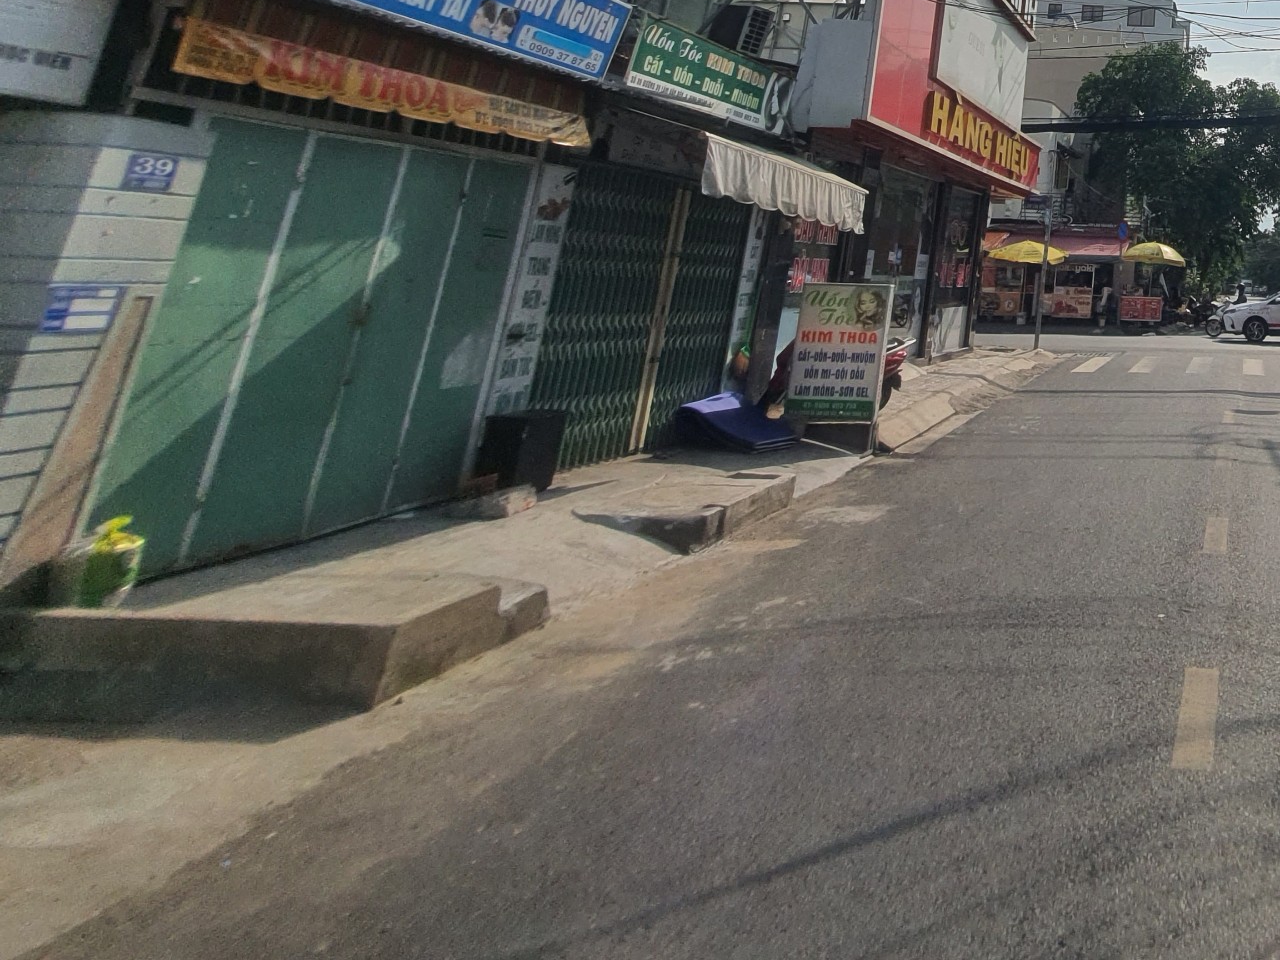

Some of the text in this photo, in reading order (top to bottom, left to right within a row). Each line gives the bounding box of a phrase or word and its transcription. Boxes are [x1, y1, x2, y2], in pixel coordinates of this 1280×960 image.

[529, 42, 597, 72] 0909 37 87 65
[359, 62, 450, 114] THOA
[930, 90, 1030, 180] HÀNG HIỆU
[133, 156, 174, 177] 39
[805, 290, 851, 307] Uốn
[800, 330, 878, 345] KIM THOA
